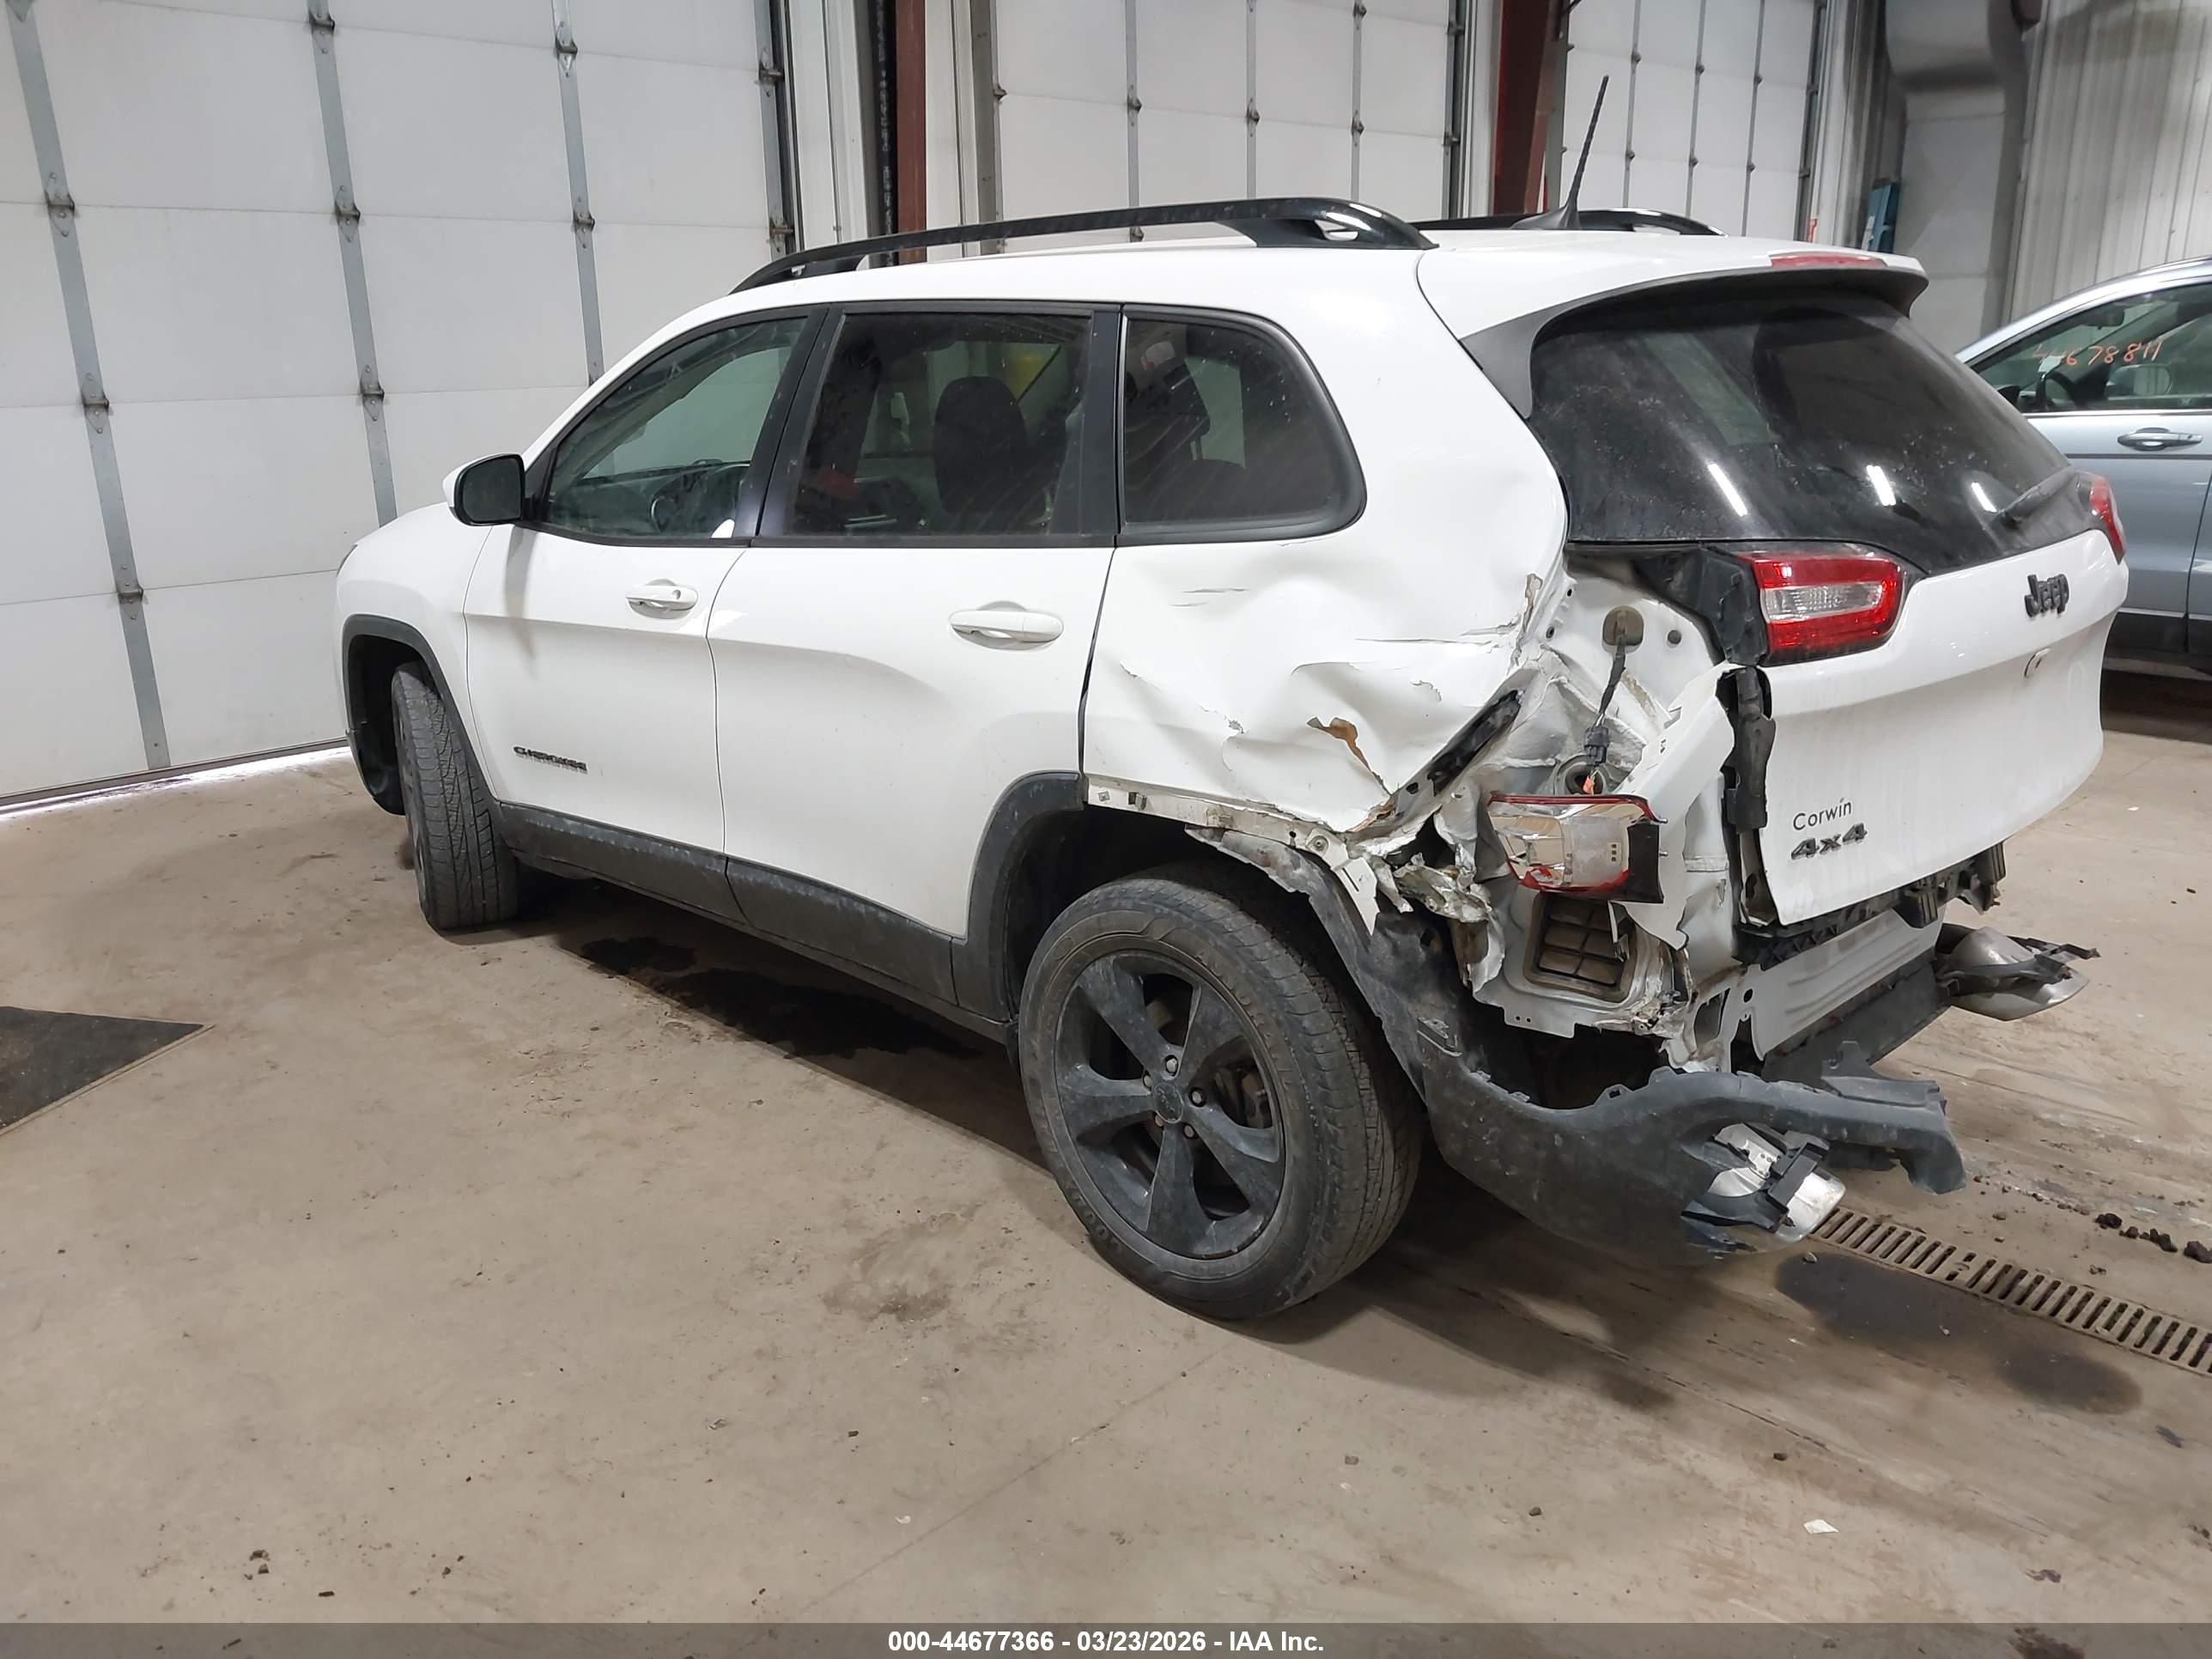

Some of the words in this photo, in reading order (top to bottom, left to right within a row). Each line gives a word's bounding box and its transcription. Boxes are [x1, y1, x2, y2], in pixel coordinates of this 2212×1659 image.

[2024, 573, 2069, 617] Jeep
[1792, 797, 1852, 831] Corwin
[1790, 823, 1868, 860] 4x4
